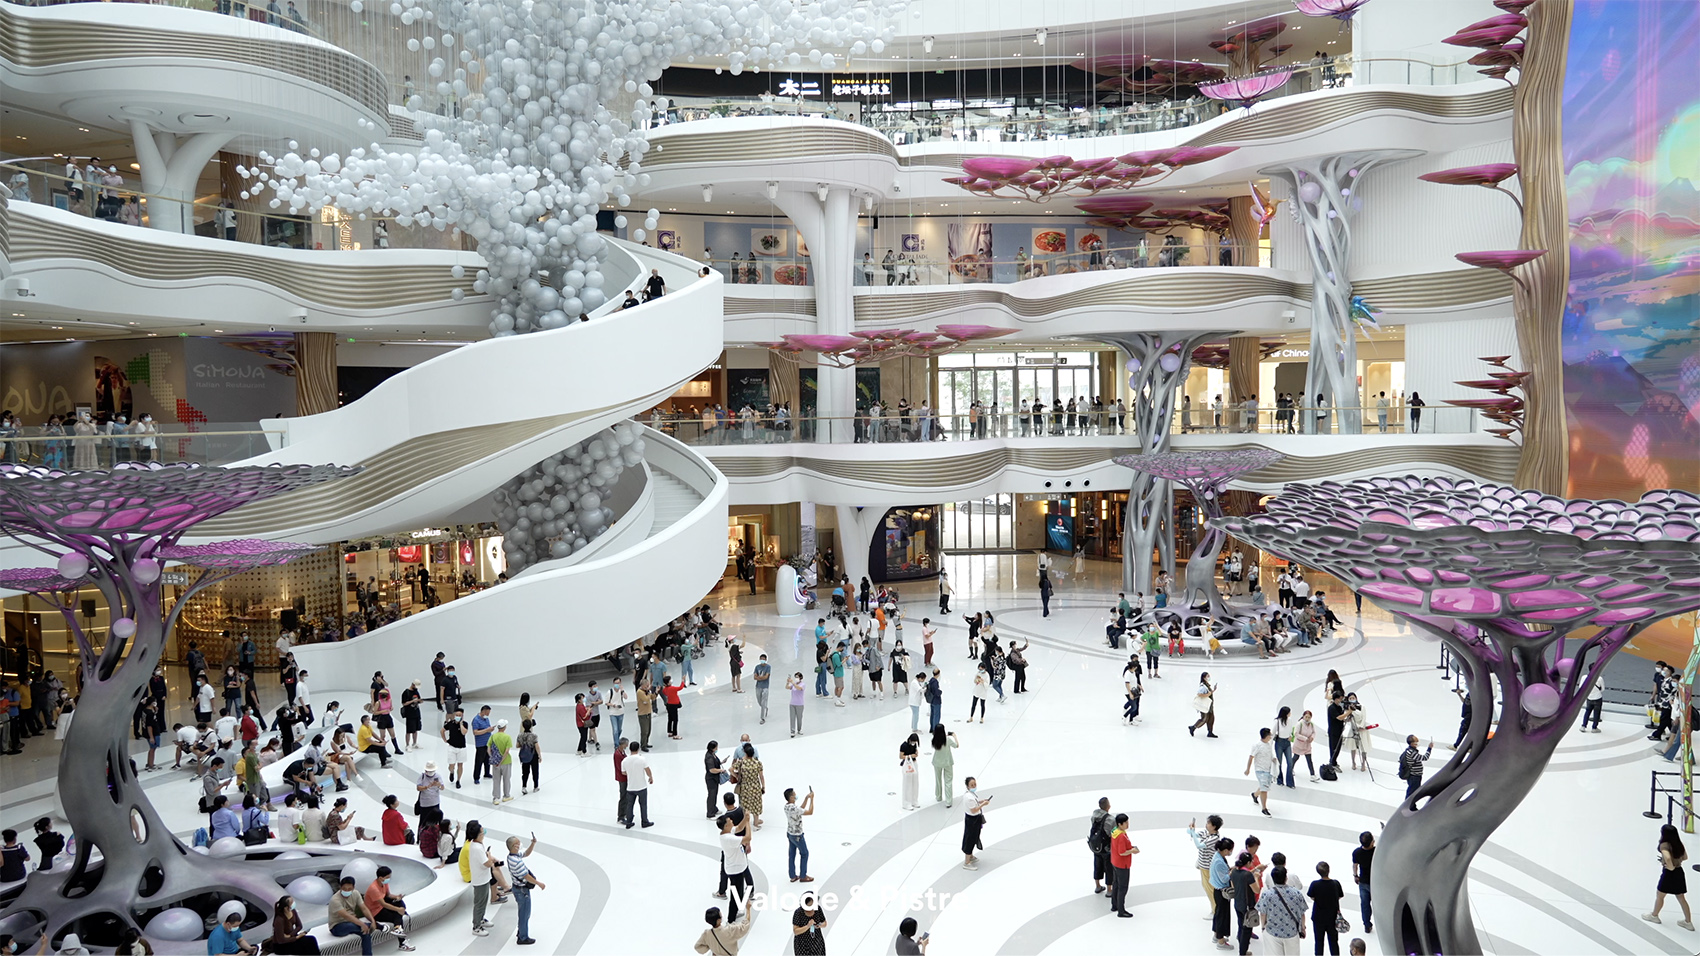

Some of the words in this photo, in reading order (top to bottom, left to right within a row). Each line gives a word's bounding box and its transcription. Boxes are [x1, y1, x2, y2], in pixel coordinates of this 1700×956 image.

[226, 381, 265, 389] Restaurant
[412, 530, 441, 538] CAMUS
[33, 617, 38, 625] 1
